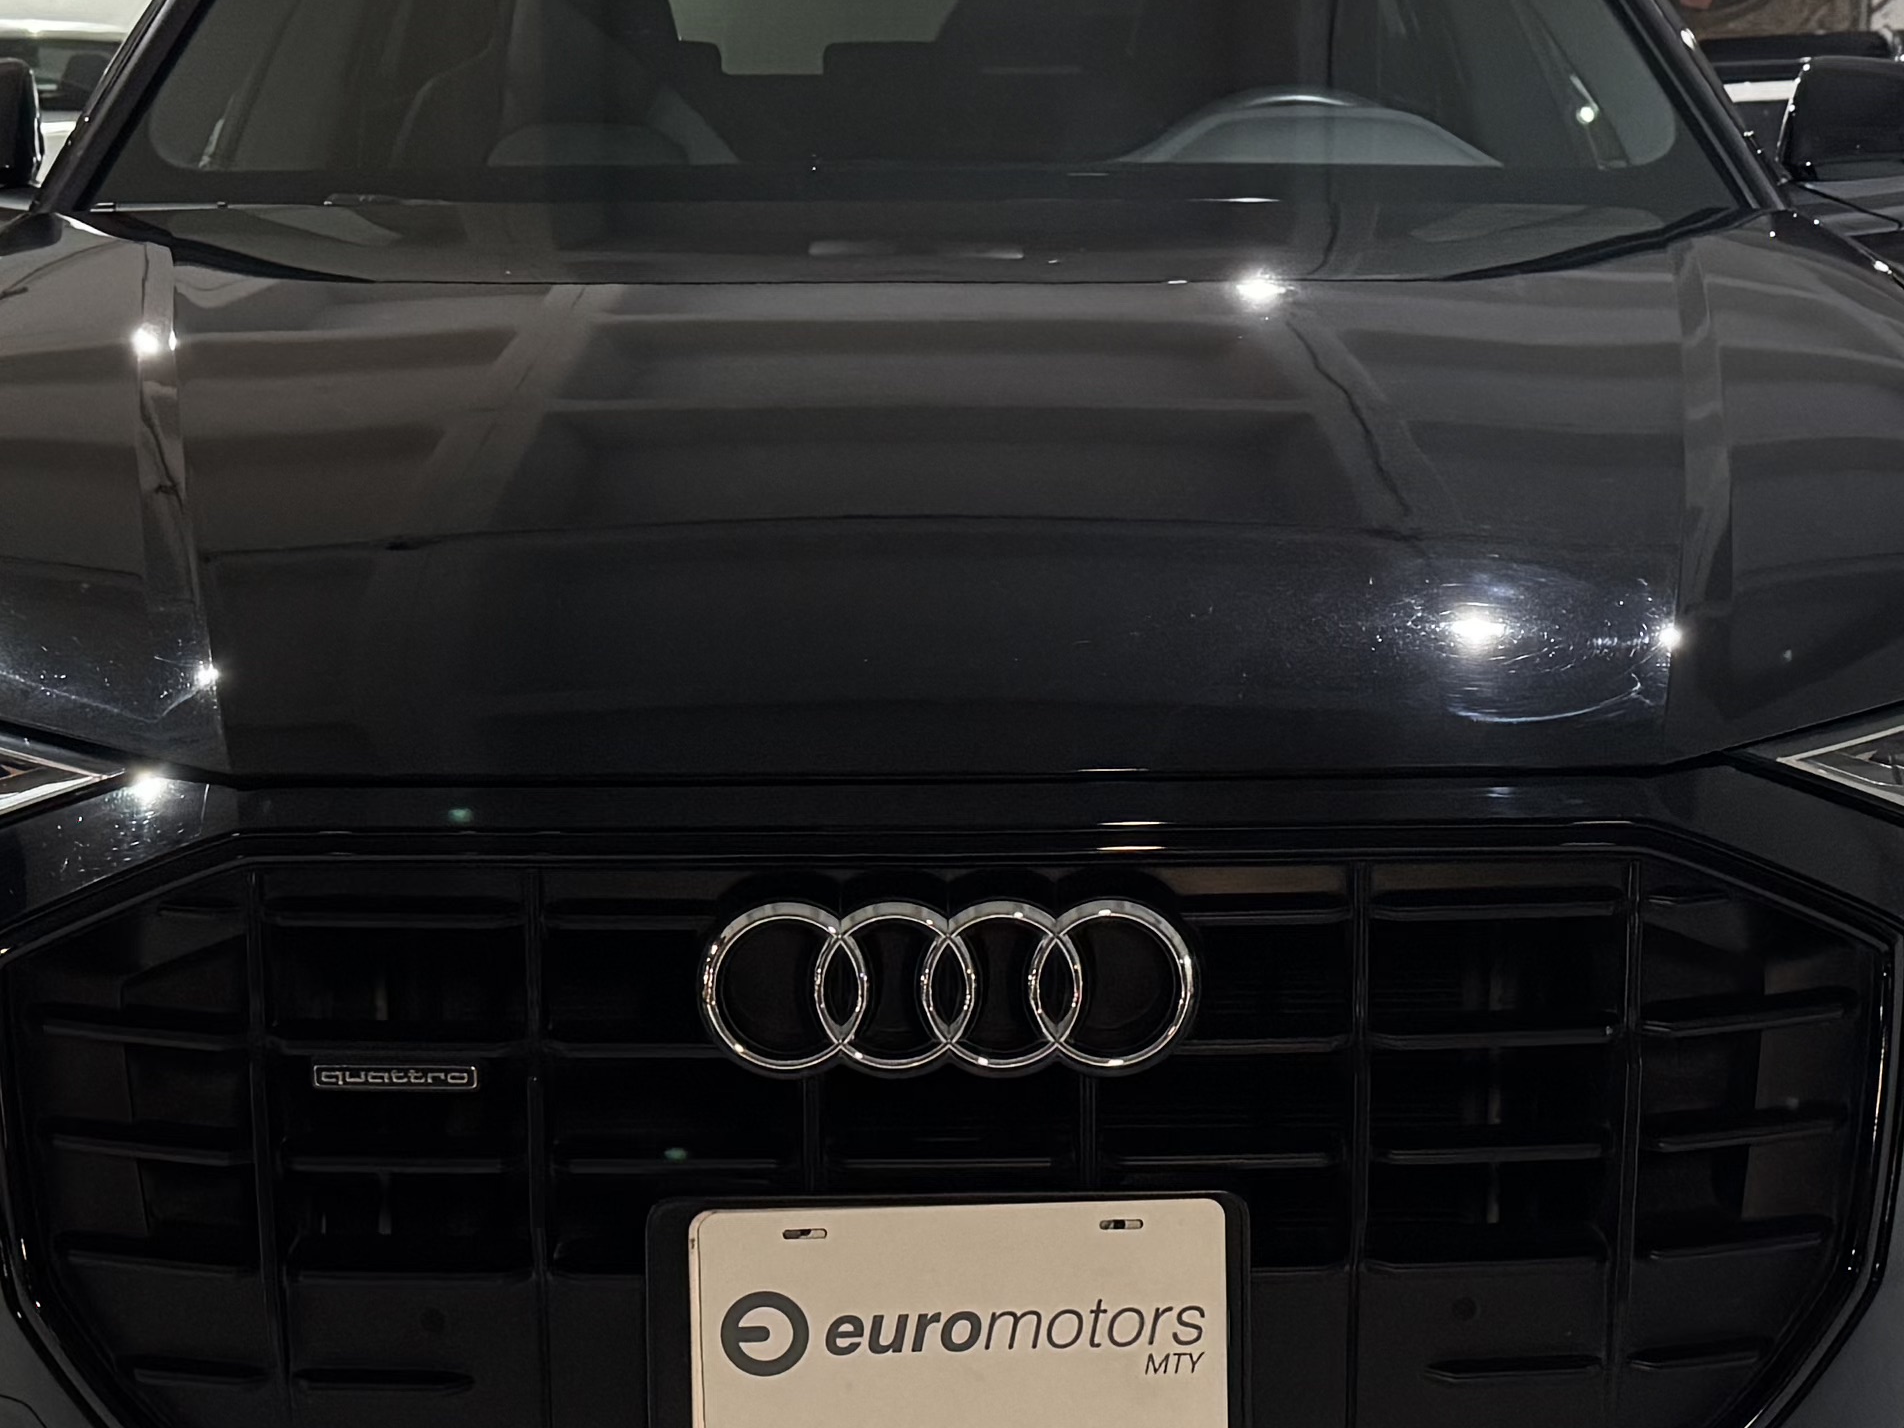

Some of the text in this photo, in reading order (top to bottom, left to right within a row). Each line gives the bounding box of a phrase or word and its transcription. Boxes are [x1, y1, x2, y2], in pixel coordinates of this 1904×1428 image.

[320, 1069, 469, 1086] quattro
[824, 1298, 1206, 1356] euromotors
[1144, 1351, 1206, 1375] MTY
